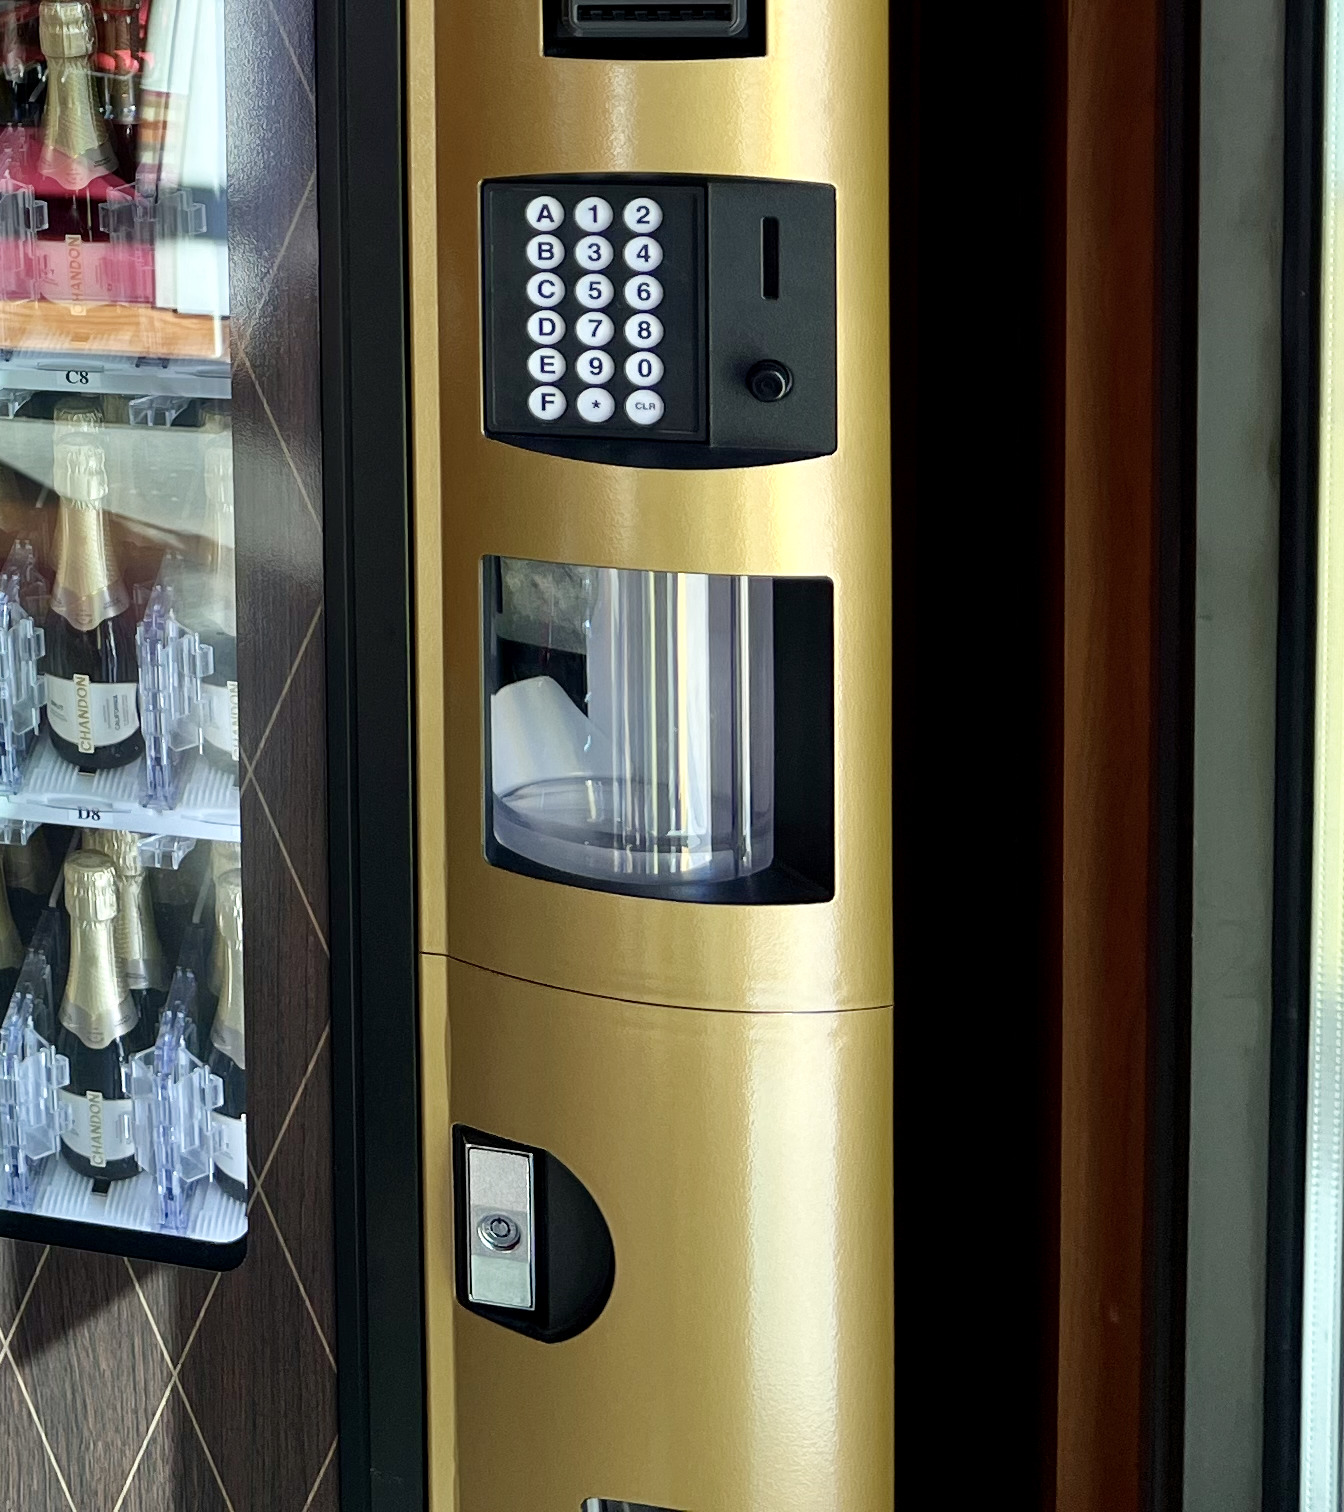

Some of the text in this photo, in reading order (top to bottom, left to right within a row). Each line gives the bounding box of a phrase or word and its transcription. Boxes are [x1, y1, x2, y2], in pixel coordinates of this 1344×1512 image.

[536, 204, 650, 224] A 1 2
[537, 241, 651, 263] B 3 4
[67, 235, 86, 315] CHANDON
[537, 279, 651, 301] C 5 6
[538, 317, 652, 340] D 7 8
[65, 369, 90, 385] C8
[540, 355, 652, 378] E 9 0
[541, 392, 656, 411] F CLR
[76, 676, 92, 752] CHANDON
[77, 806, 102, 821] D8
[88, 1092, 103, 1165] CHANDON
